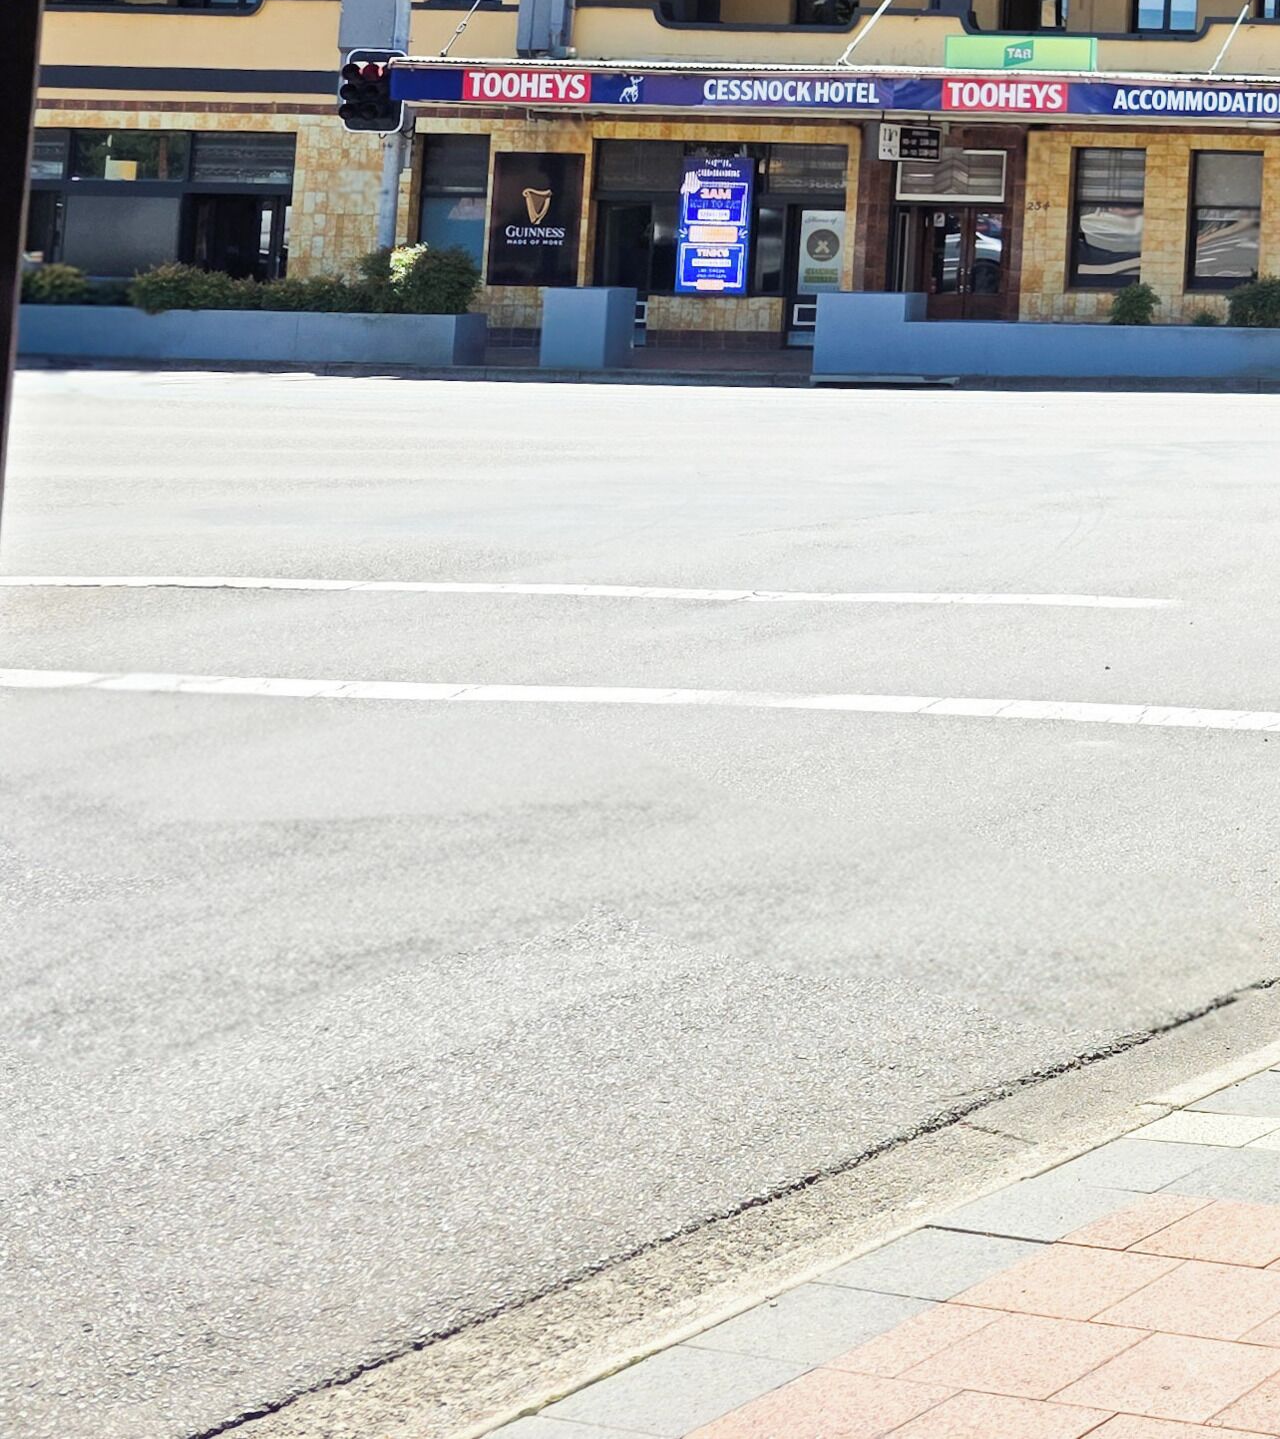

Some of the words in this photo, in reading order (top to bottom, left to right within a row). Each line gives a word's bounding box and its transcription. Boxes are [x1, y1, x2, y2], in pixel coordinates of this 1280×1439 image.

[469, 72, 586, 100] TOOHEYS
[703, 78, 811, 102] CESSNOCK
[814, 81, 880, 104] HOTEL
[947, 82, 1063, 109] TOOHEYS
[505, 224, 566, 238] GUINNESS
